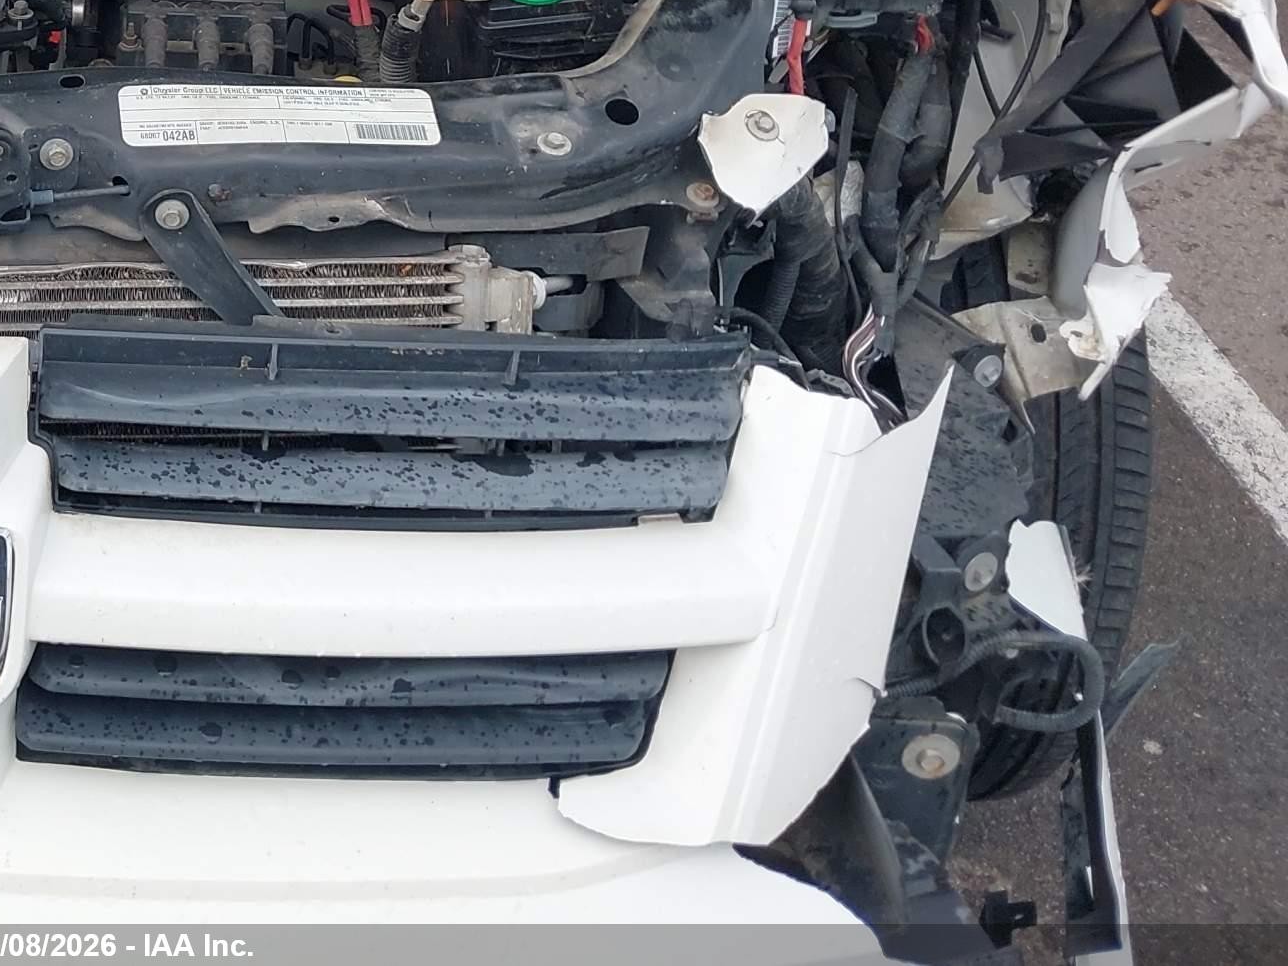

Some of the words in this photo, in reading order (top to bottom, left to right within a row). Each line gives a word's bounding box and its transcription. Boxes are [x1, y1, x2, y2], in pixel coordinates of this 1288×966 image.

[153, 87, 181, 95] Chrysler
[182, 87, 204, 95] Group
[162, 130, 196, 141] 042AB
